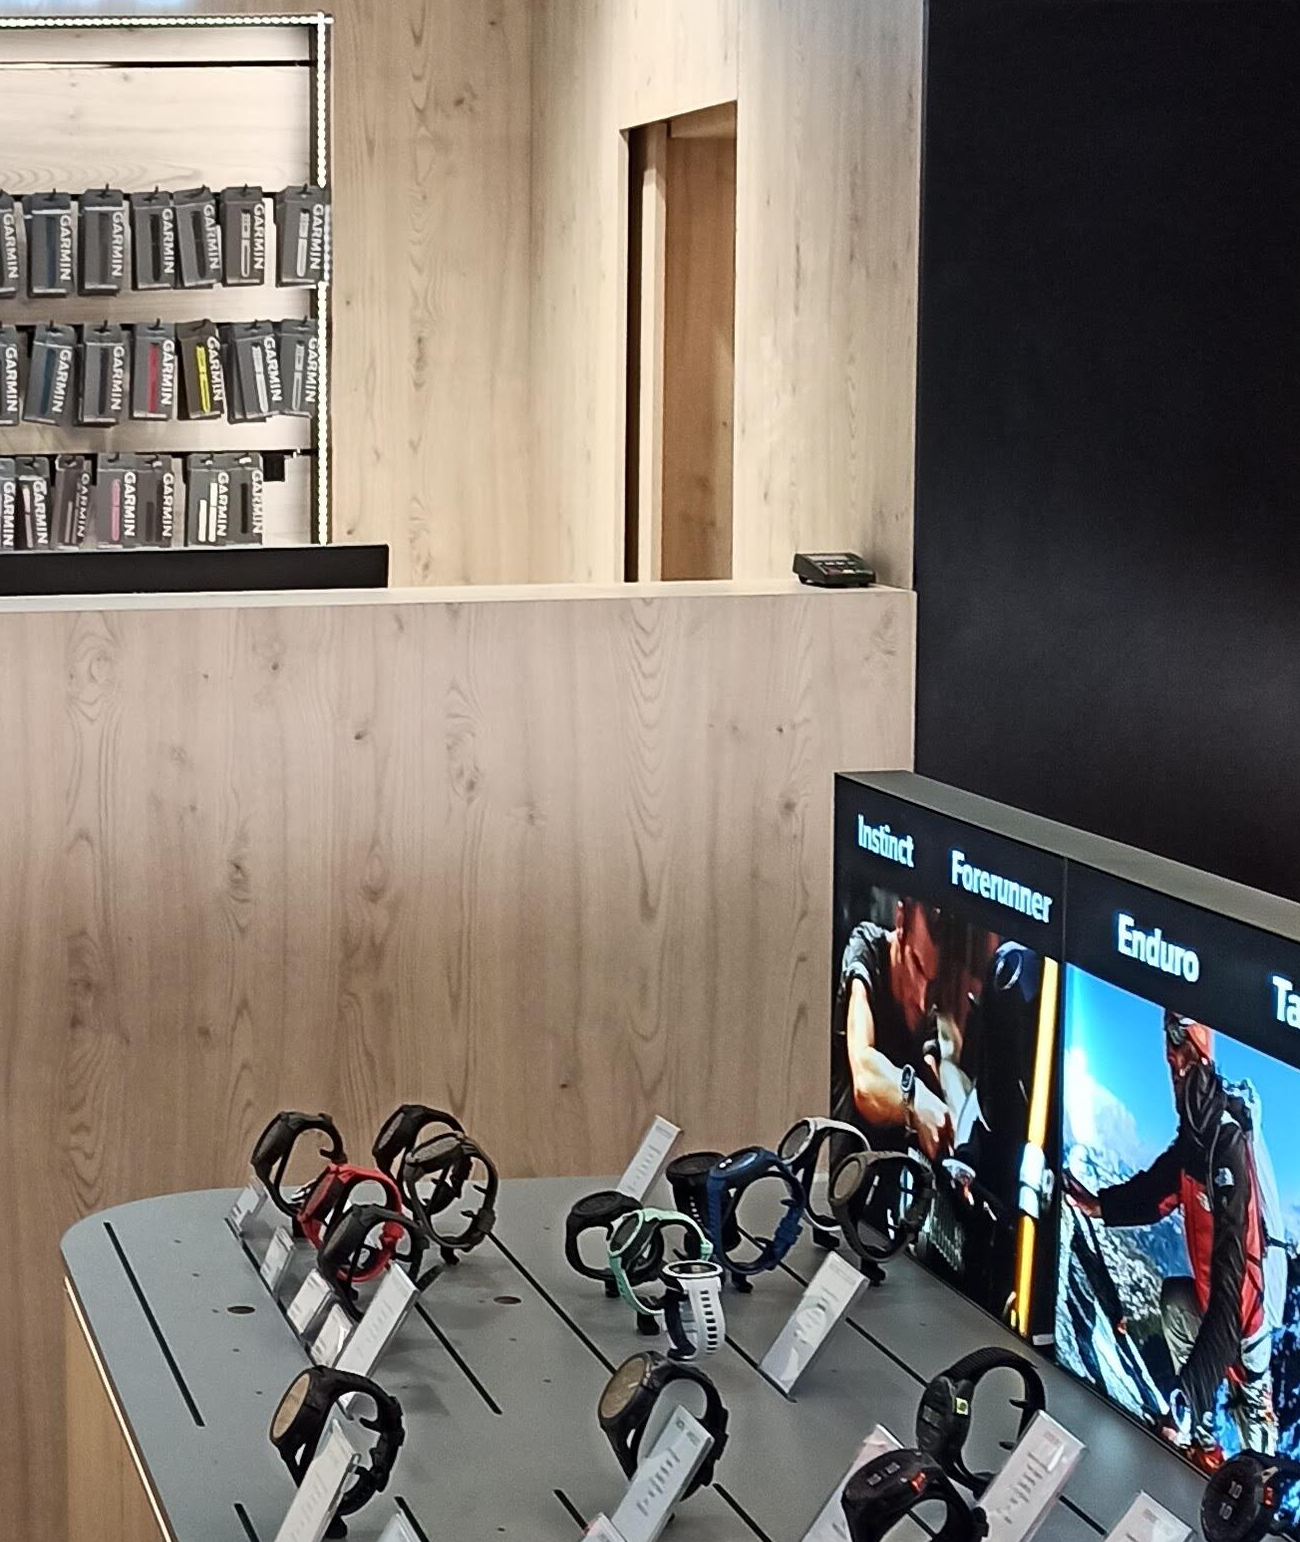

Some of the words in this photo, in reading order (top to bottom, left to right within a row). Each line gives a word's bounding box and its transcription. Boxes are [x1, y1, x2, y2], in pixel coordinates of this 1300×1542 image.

[4, 213, 19, 279] GARMIN
[59, 214, 71, 281] GARMIN
[112, 211, 124, 277] GARMIN
[162, 209, 175, 274] GARMIN
[204, 205, 220, 270] GARMIN
[253, 204, 264, 270] GARMIN
[310, 204, 324, 270] GARMIN
[5, 347, 18, 412] GARMIN
[51, 349, 71, 413] GARMIN
[111, 347, 124, 412] GARMIN
[161, 340, 174, 405] GARMIN
[206, 336, 222, 401] GARMIN
[263, 336, 281, 401] GARMIN
[306, 338, 318, 402] GARMIN
[3, 482, 15, 547] GARMIN
[33, 480, 48, 544] GARMIN
[124, 472, 136, 537] GARMIN
[162, 473, 173, 537] GARMIN
[218, 472, 229, 537] GARMIN
[252, 470, 263, 534] GARMIN
[857, 813, 914, 868] Instinct
[951, 850, 1053, 923] Forerunner
[1118, 913, 1200, 983] Enduro
